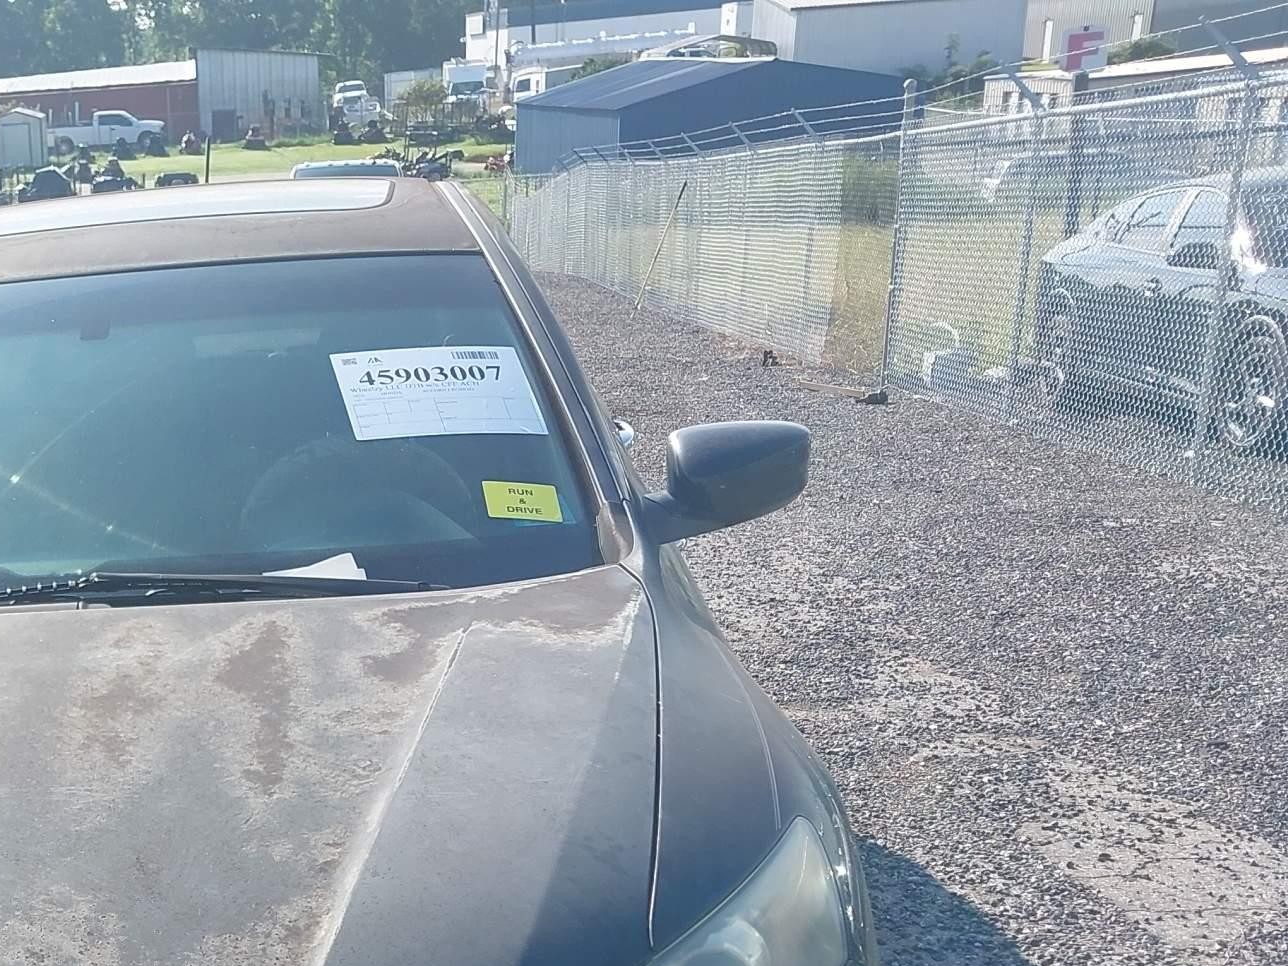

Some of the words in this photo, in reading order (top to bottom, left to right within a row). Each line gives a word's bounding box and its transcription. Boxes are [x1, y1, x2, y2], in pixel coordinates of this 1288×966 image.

[359, 365, 501, 386] 45903007
[508, 488, 534, 496] RUN
[506, 506, 543, 515] DRIVE
